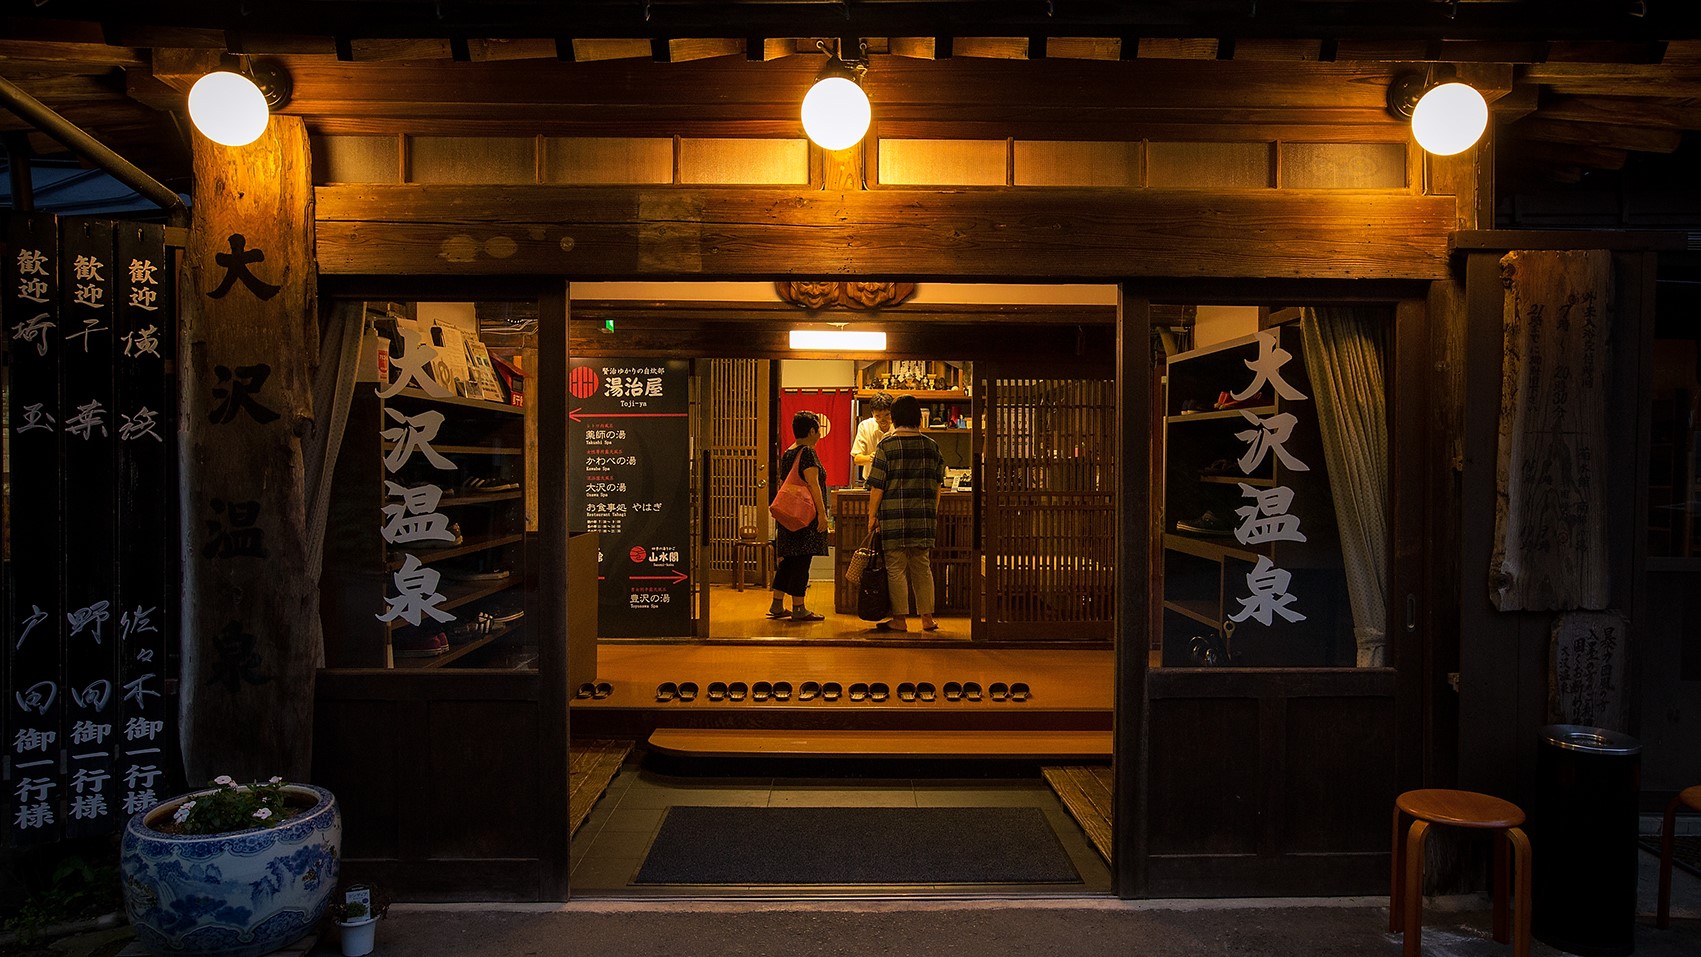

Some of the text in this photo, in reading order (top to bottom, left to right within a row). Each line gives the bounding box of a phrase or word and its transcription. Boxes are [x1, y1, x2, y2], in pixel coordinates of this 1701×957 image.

[16, 248, 50, 303] 歓迎
[73, 254, 105, 308] 歓迎
[128, 258, 159, 311] 歓迎
[604, 377, 664, 398] 湯治屋
[619, 400, 647, 408] Toji-ya
[585, 430, 626, 440] 薬師の湯
[586, 456, 637, 466] かわべの湯
[203, 233, 281, 693] 大沢温泉
[374, 326, 458, 627] 大沢温泉
[586, 482, 627, 493] 大沢の湯
[1227, 331, 1309, 626] 大沢温泉
[586, 502, 663, 513] お食事処 やはぎ
[648, 551, 679, 563] 山水閣
[629, 594, 670, 604] 豊沢の湯
[12, 727, 57, 829] 御一行様
[69, 720, 112, 820] 御一行様
[122, 716, 165, 815] 御一行様
